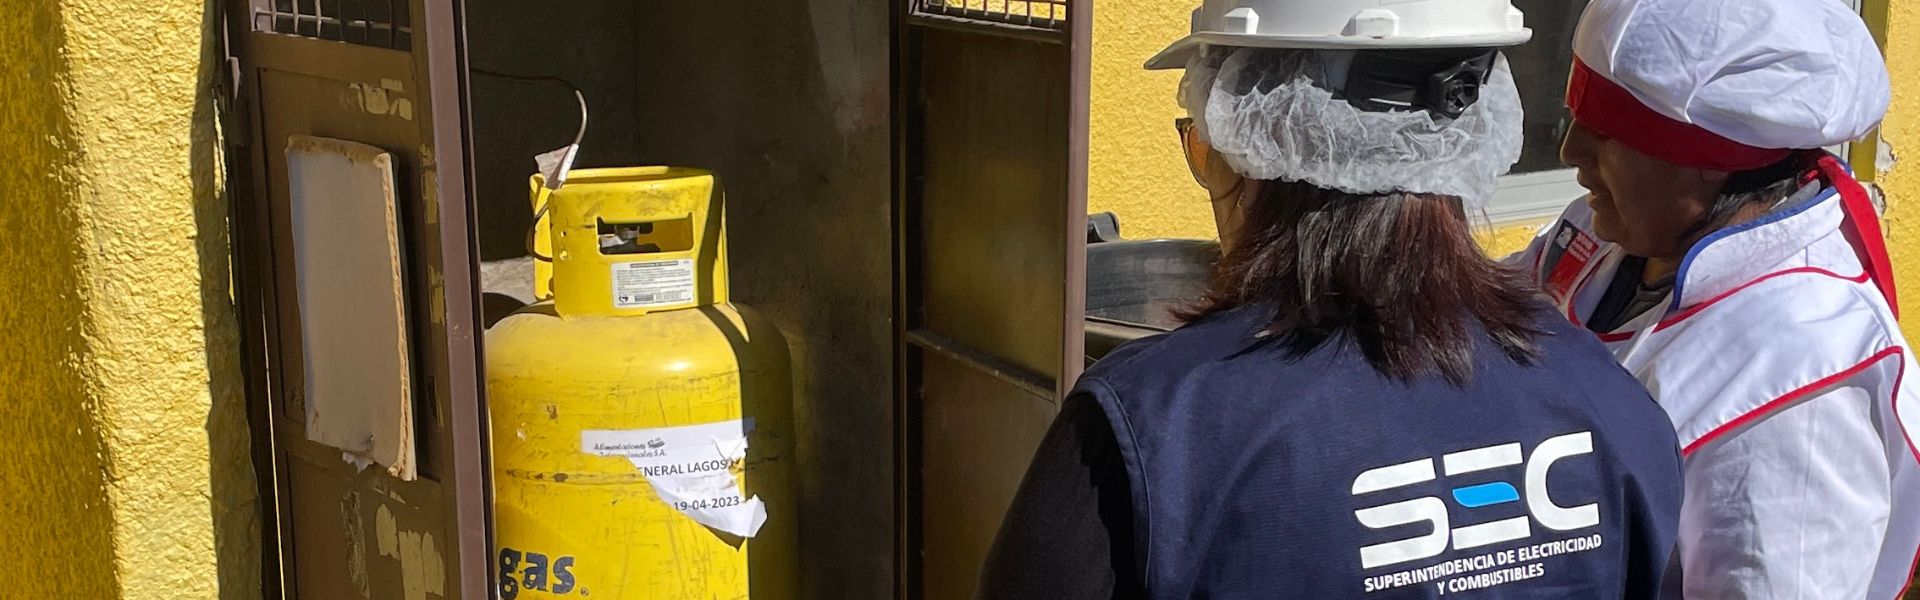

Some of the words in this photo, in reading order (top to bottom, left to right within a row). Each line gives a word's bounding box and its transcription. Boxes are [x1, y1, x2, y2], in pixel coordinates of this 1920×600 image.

[687, 460, 728, 473] LAGOS
[673, 495, 740, 511] 19-04-2023
[1352, 431, 1600, 569] SEC
[1364, 552, 1496, 592] SUPERINTENDENCIA
[1497, 549, 1516, 565] DE
[1518, 533, 1603, 561] ELECTRICIDAD
[1437, 581, 1445, 595] Y
[1448, 562, 1545, 593] COMBUSTIBLES
